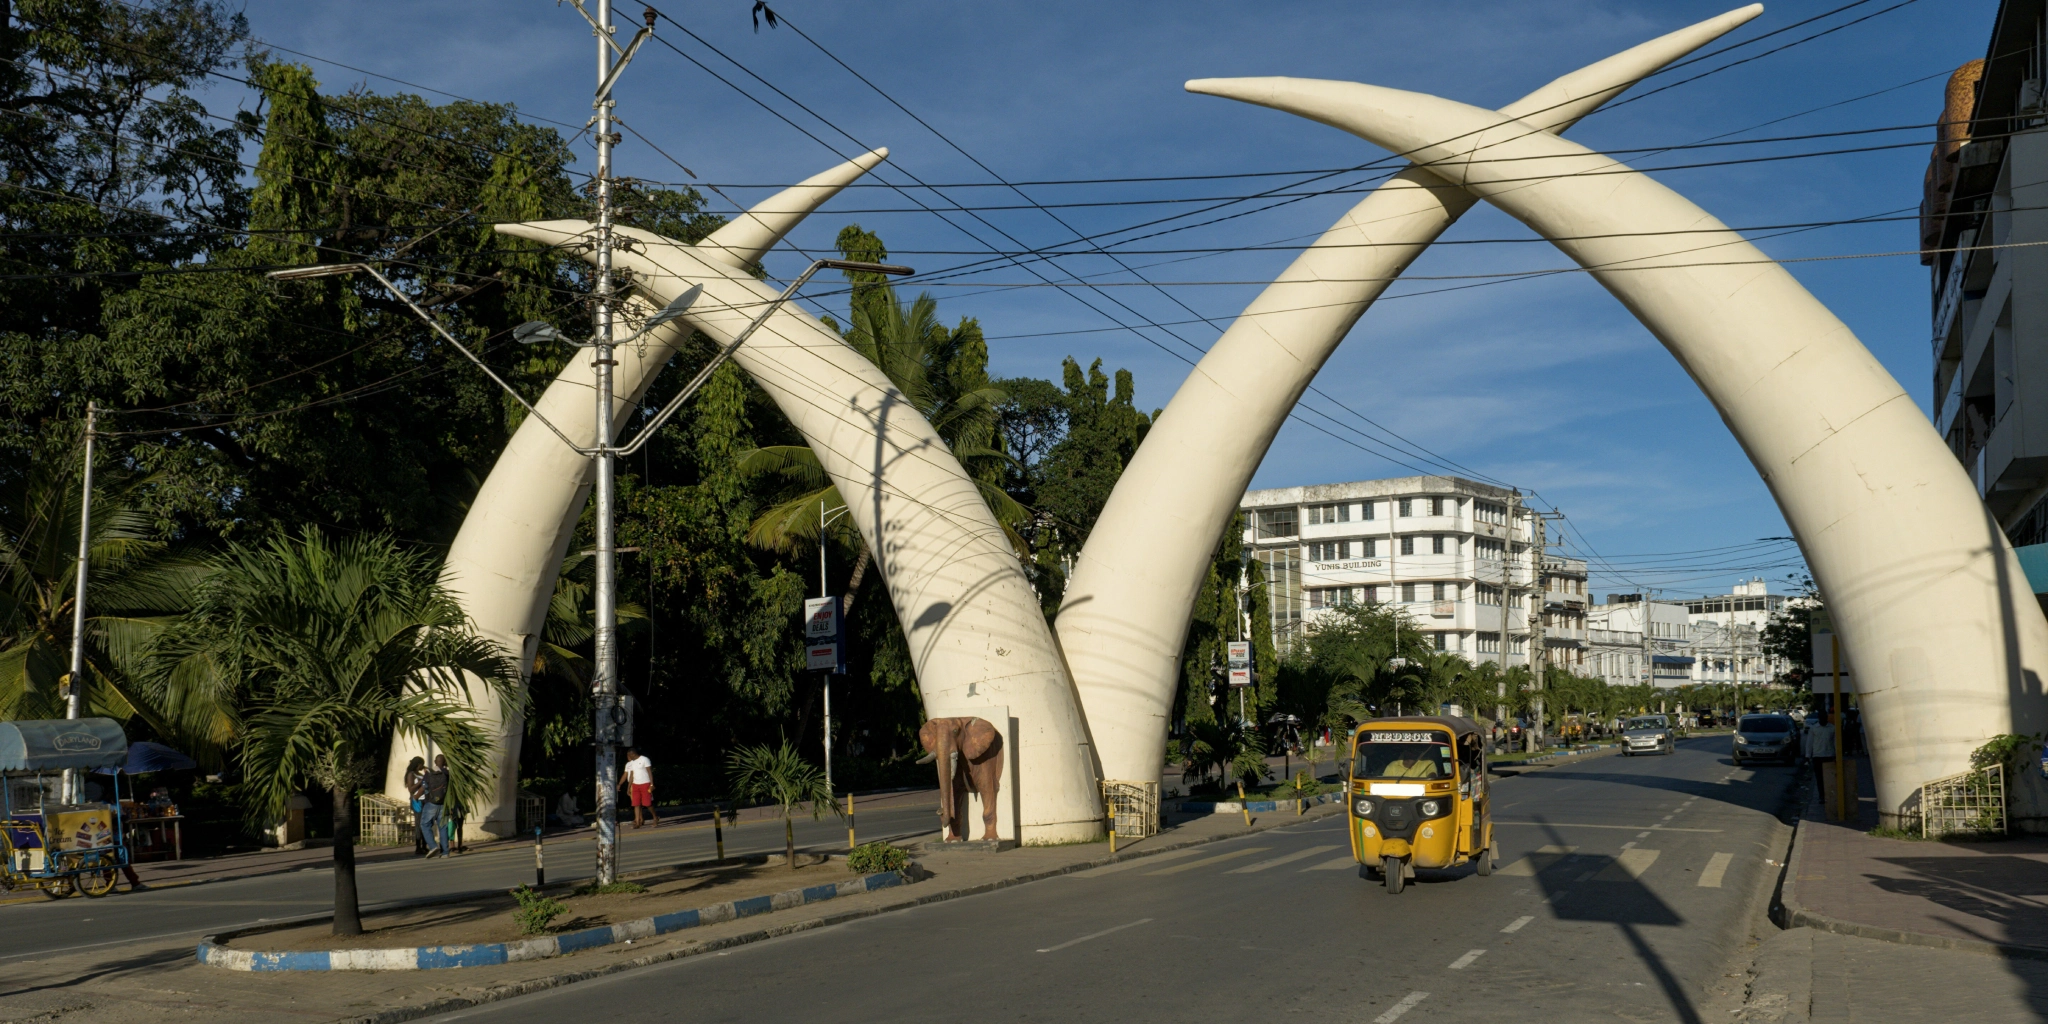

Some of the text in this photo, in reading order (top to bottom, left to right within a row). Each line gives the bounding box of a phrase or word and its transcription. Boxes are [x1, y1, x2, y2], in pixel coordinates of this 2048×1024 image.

[1315, 560, 1381, 571] YUNIS BUILDING
[814, 611, 832, 621] ENJOY
[813, 623, 828, 632] DEALS
[58, 736, 98, 747] DAIRYLAND
[54, 827, 65, 836] Ice
[49, 837, 72, 845] Cream
